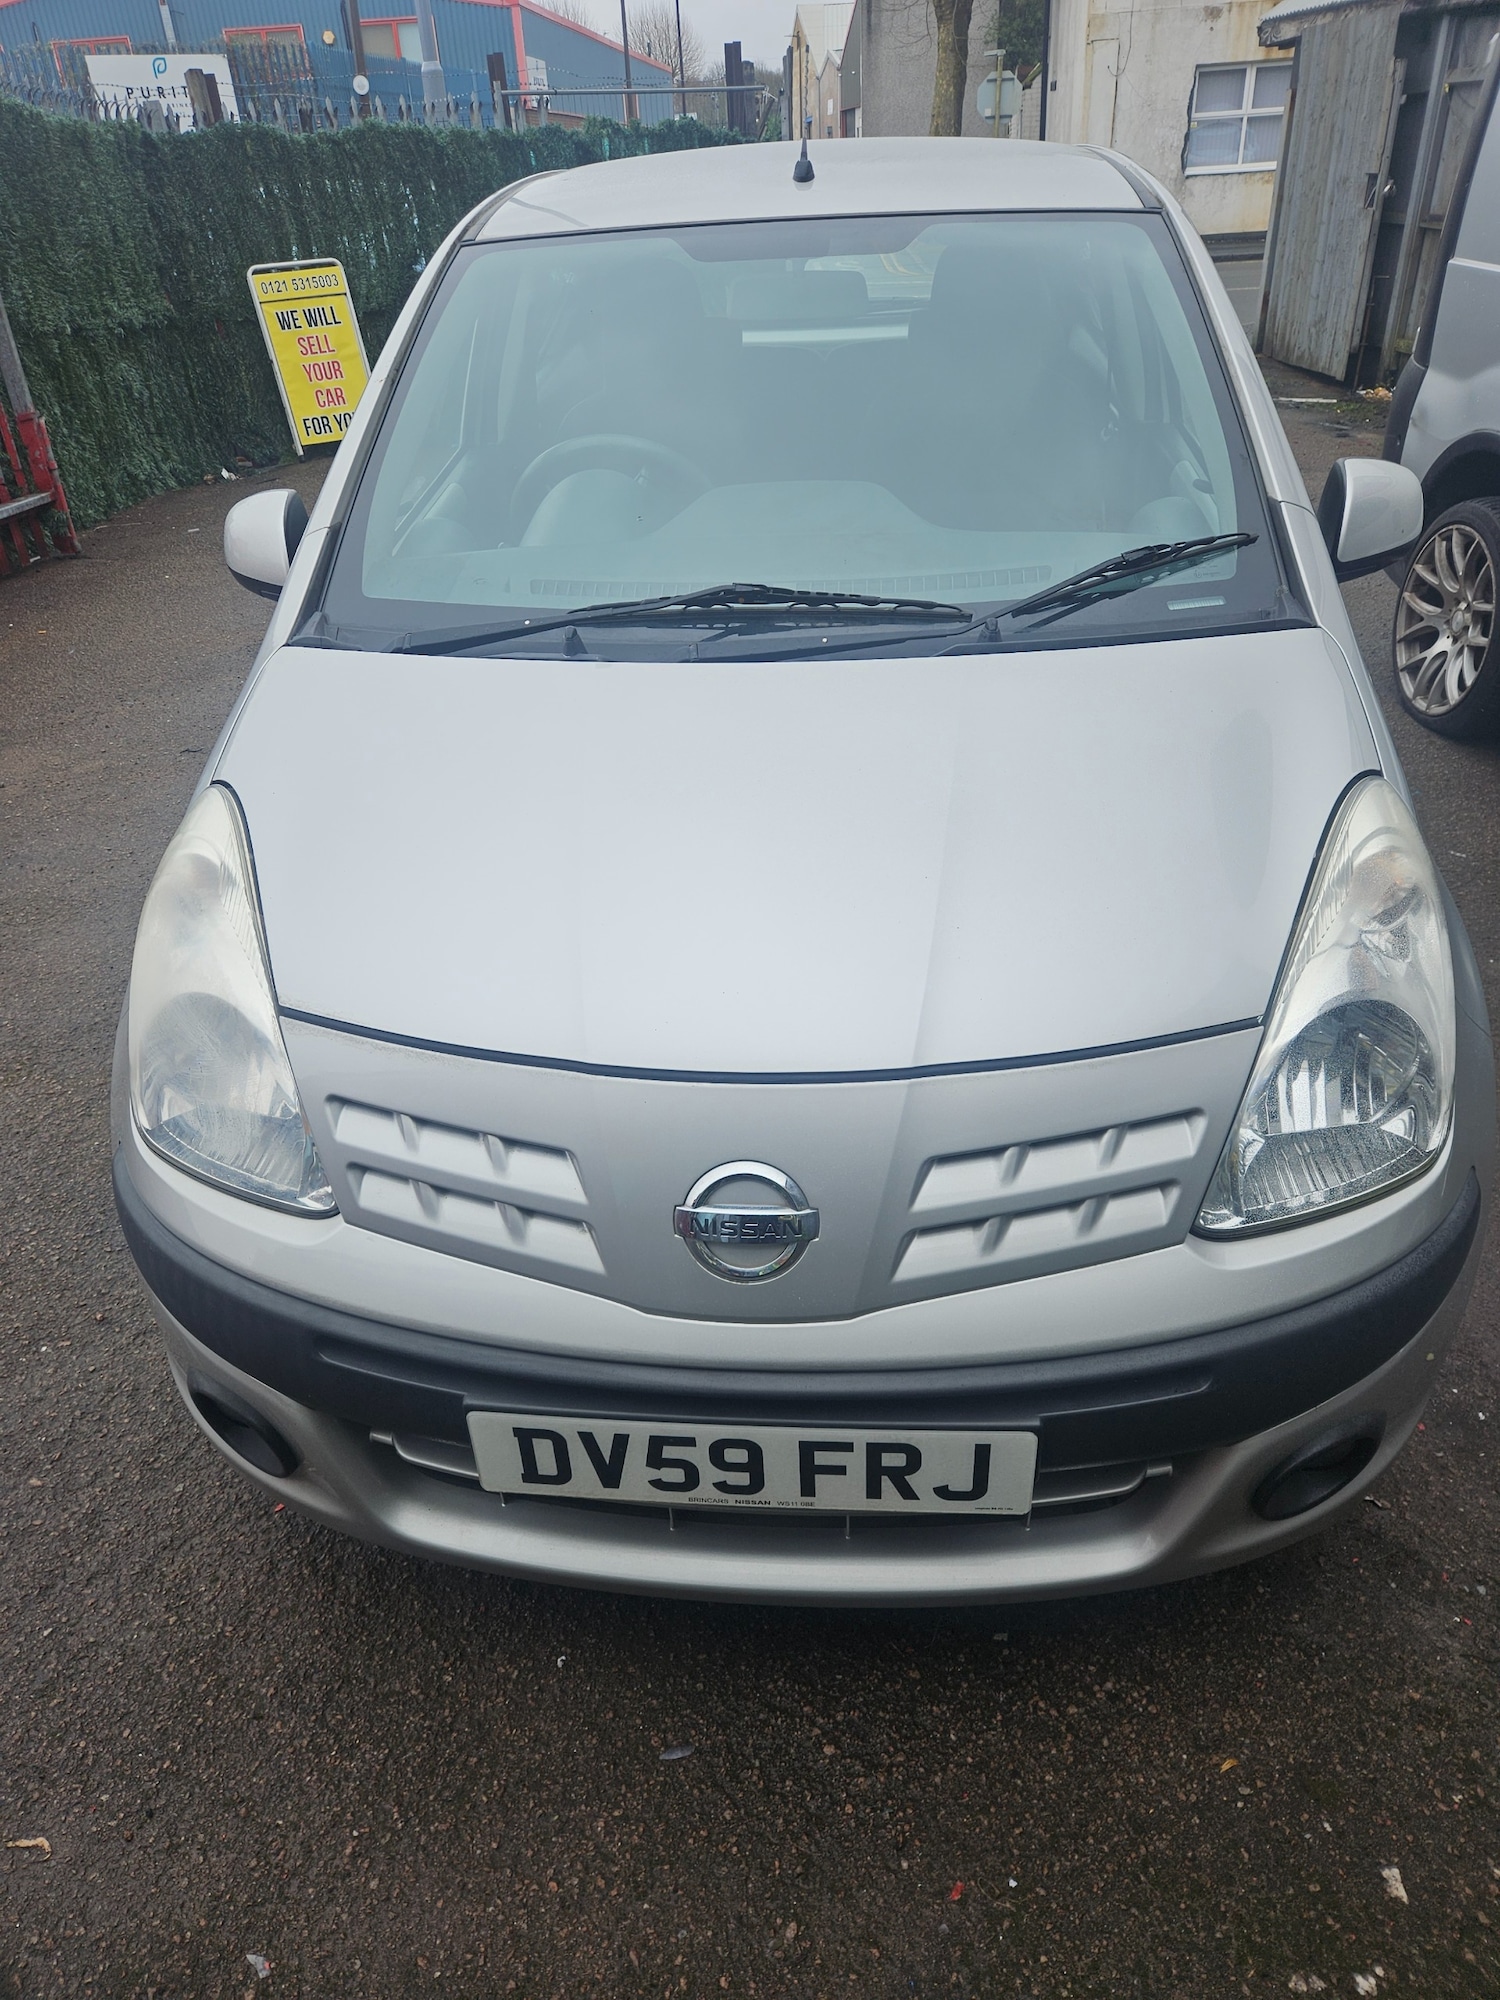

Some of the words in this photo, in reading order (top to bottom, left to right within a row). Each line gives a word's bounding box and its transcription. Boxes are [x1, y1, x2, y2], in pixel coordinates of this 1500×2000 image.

[126, 86, 189, 99] PURIT
[261, 280, 288, 294] 0121
[290, 274, 339, 291] 5315003
[275, 310, 302, 330] WE
[302, 306, 341, 326] WILL
[297, 335, 335, 356] SELL
[302, 360, 344, 381] YOUR
[315, 388, 346, 407] CAR
[303, 415, 333, 436] FOR
[332, 412, 355, 431] YO
[690, 1218, 802, 1239] NISSAN
[512, 1427, 764, 1495] DV59
[798, 1440, 991, 1501] FRJ
